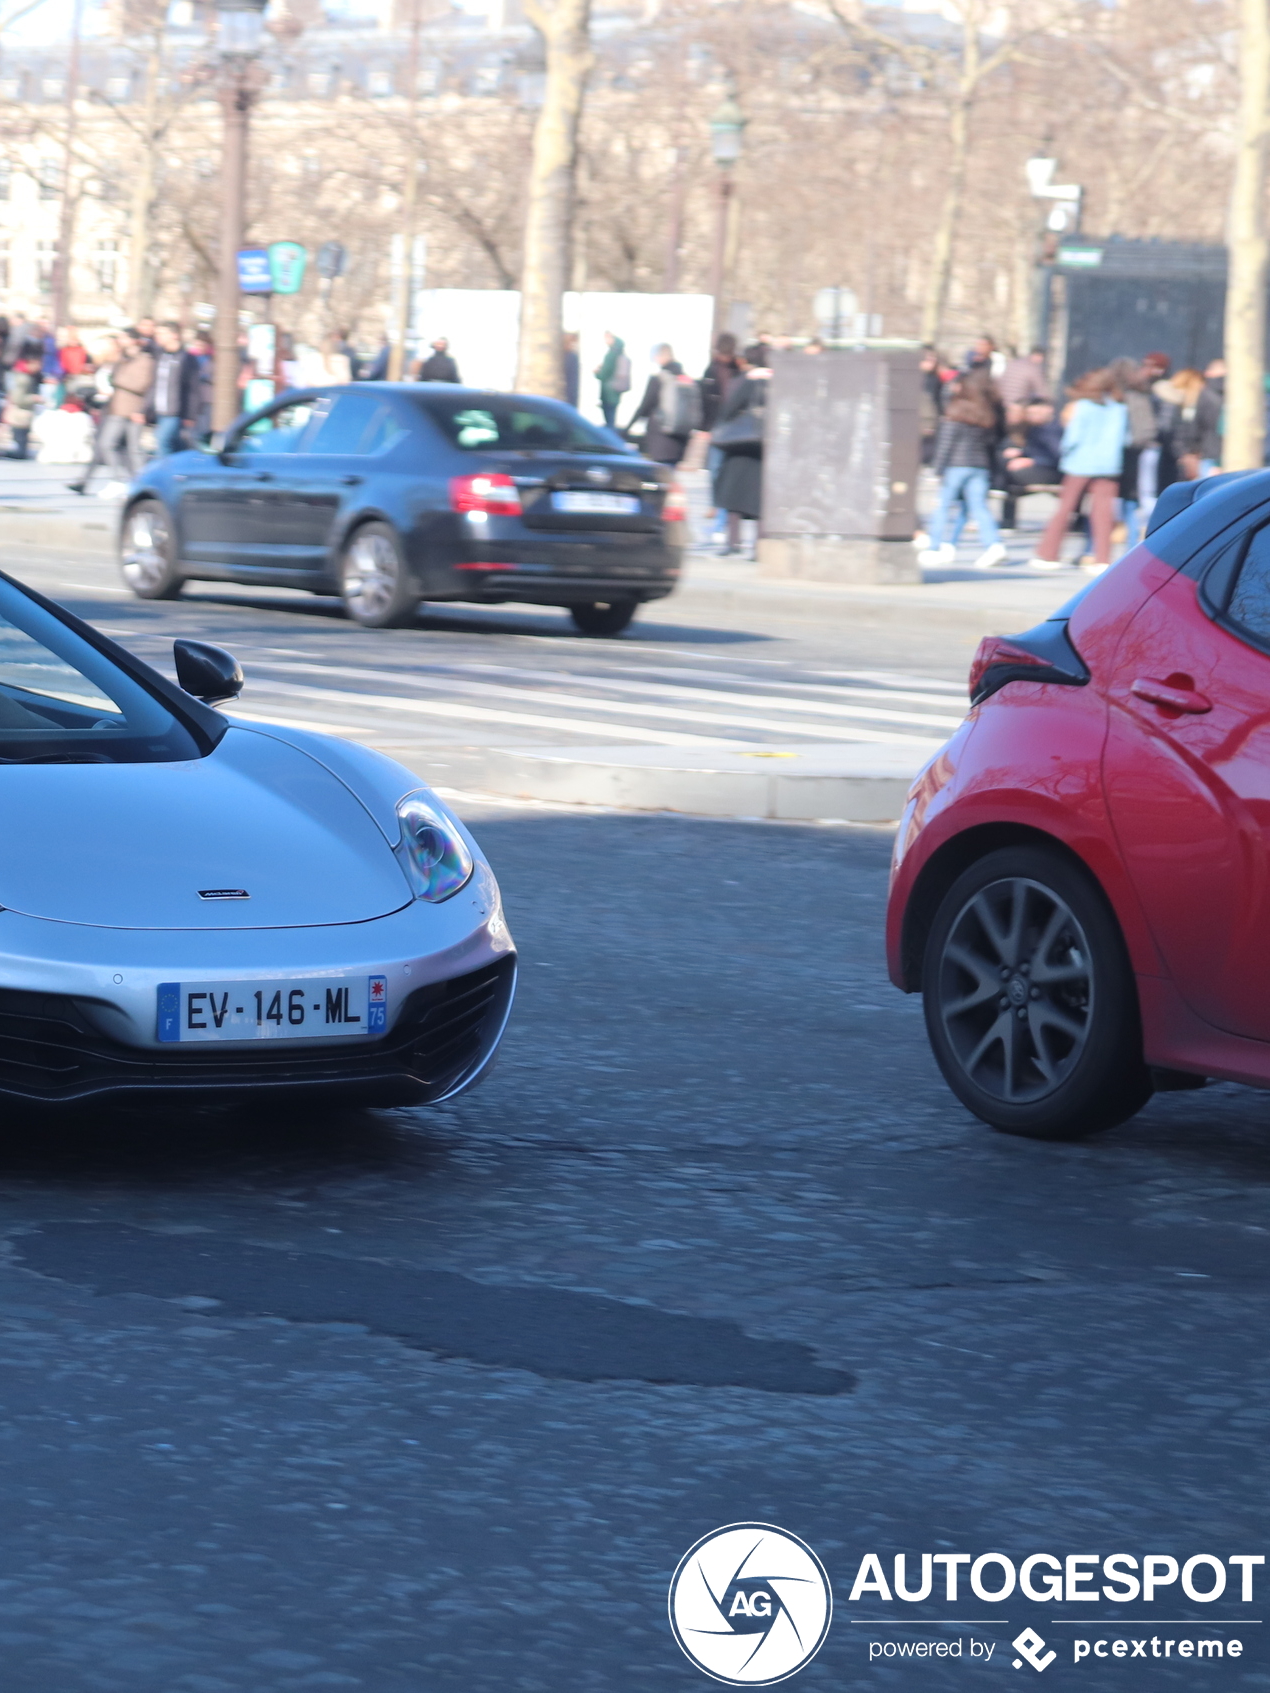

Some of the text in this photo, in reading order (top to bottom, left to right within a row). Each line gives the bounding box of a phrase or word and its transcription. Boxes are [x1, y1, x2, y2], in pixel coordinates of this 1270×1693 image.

[187, 987, 361, 1029] EV-146-ML
[370, 1007, 385, 1026] 75
[165, 1018, 173, 1031] F
